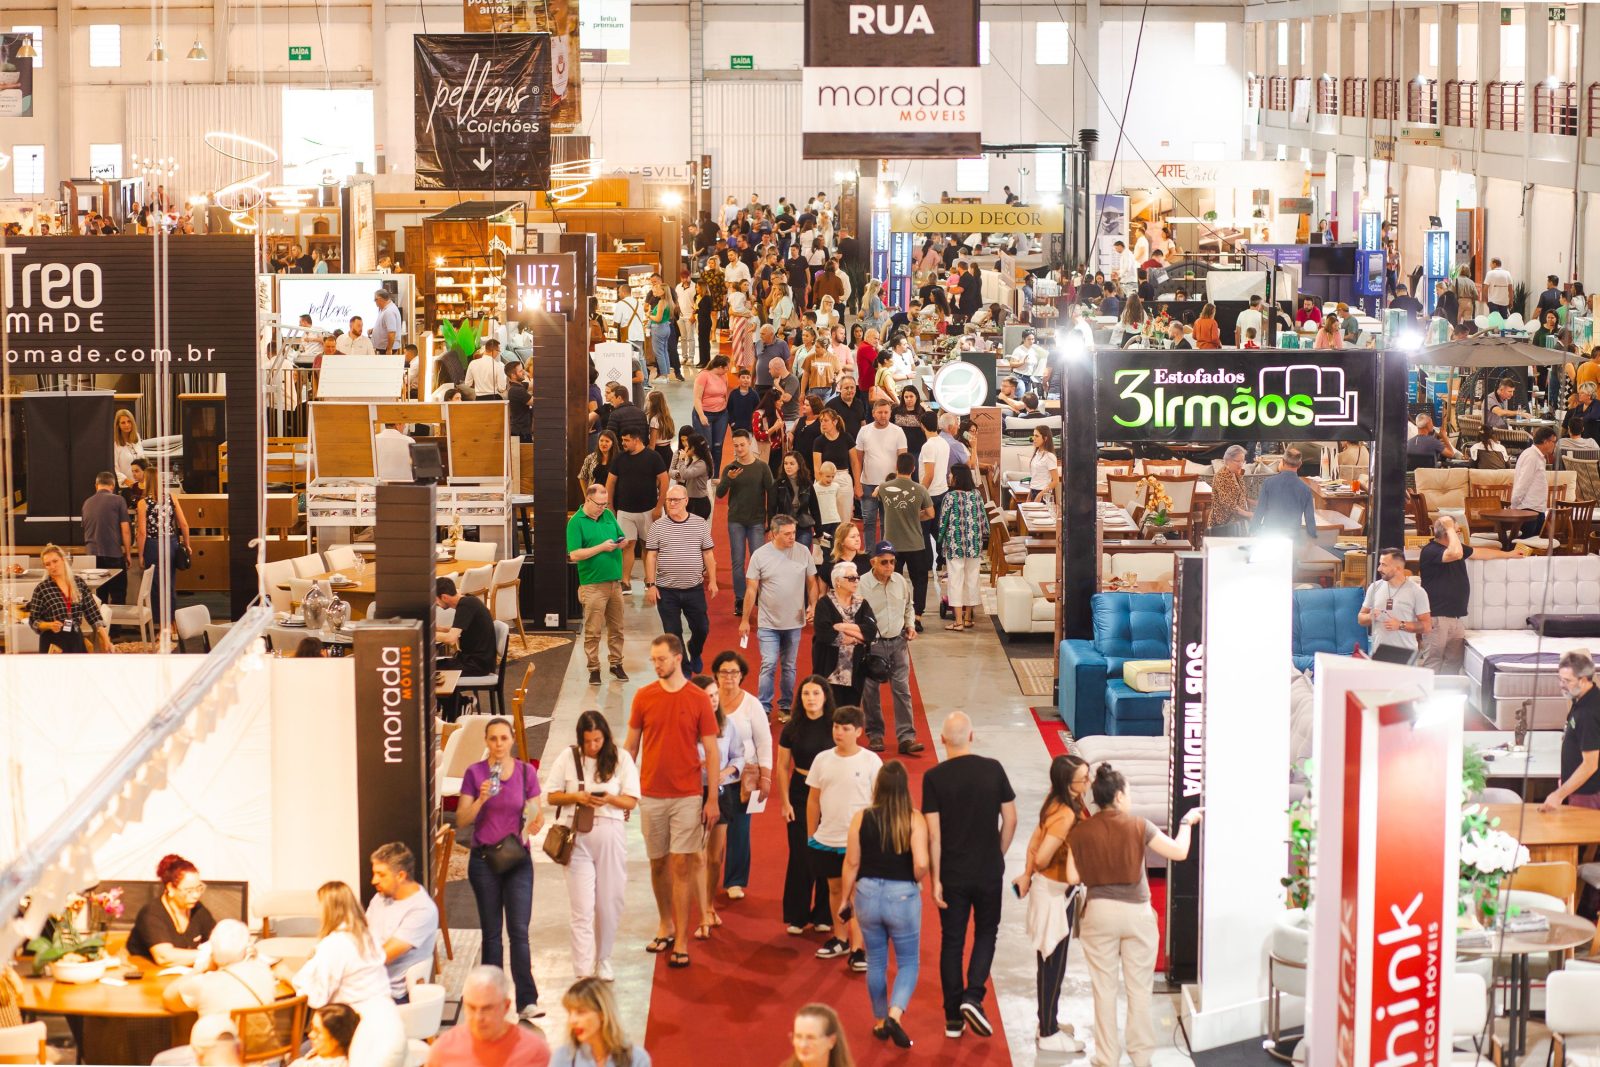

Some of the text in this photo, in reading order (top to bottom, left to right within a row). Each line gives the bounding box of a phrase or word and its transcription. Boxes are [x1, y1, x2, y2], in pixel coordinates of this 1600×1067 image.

[480, 6, 510, 15] arroz
[849, 4, 935, 35] RUA
[732, 56, 751, 64] SAÍDA
[426, 53, 530, 133] pellens
[818, 78, 966, 107] morada
[900, 108, 966, 121] MÓVEIS
[467, 119, 540, 133] Colchões
[1155, 164, 1186, 178] ARTE
[912, 208, 1042, 227] GOLD DECOR
[0, 246, 103, 309] Treo
[516, 264, 560, 286] LUTZ
[517, 301, 561, 313] DOR
[5, 311, 104, 333] MADE
[5, 344, 216, 363] omade.com.br
[1153, 368, 1246, 385] Estofados
[1112, 369, 1314, 428] 3 Irmãos
[400, 645, 413, 700] MÓVEIS
[375, 646, 403, 763] morada
[1182, 641, 1203, 798] SUB MEDIDA
[1425, 920, 1439, 999] MÓVEIS
[1373, 891, 1425, 1067] hink
